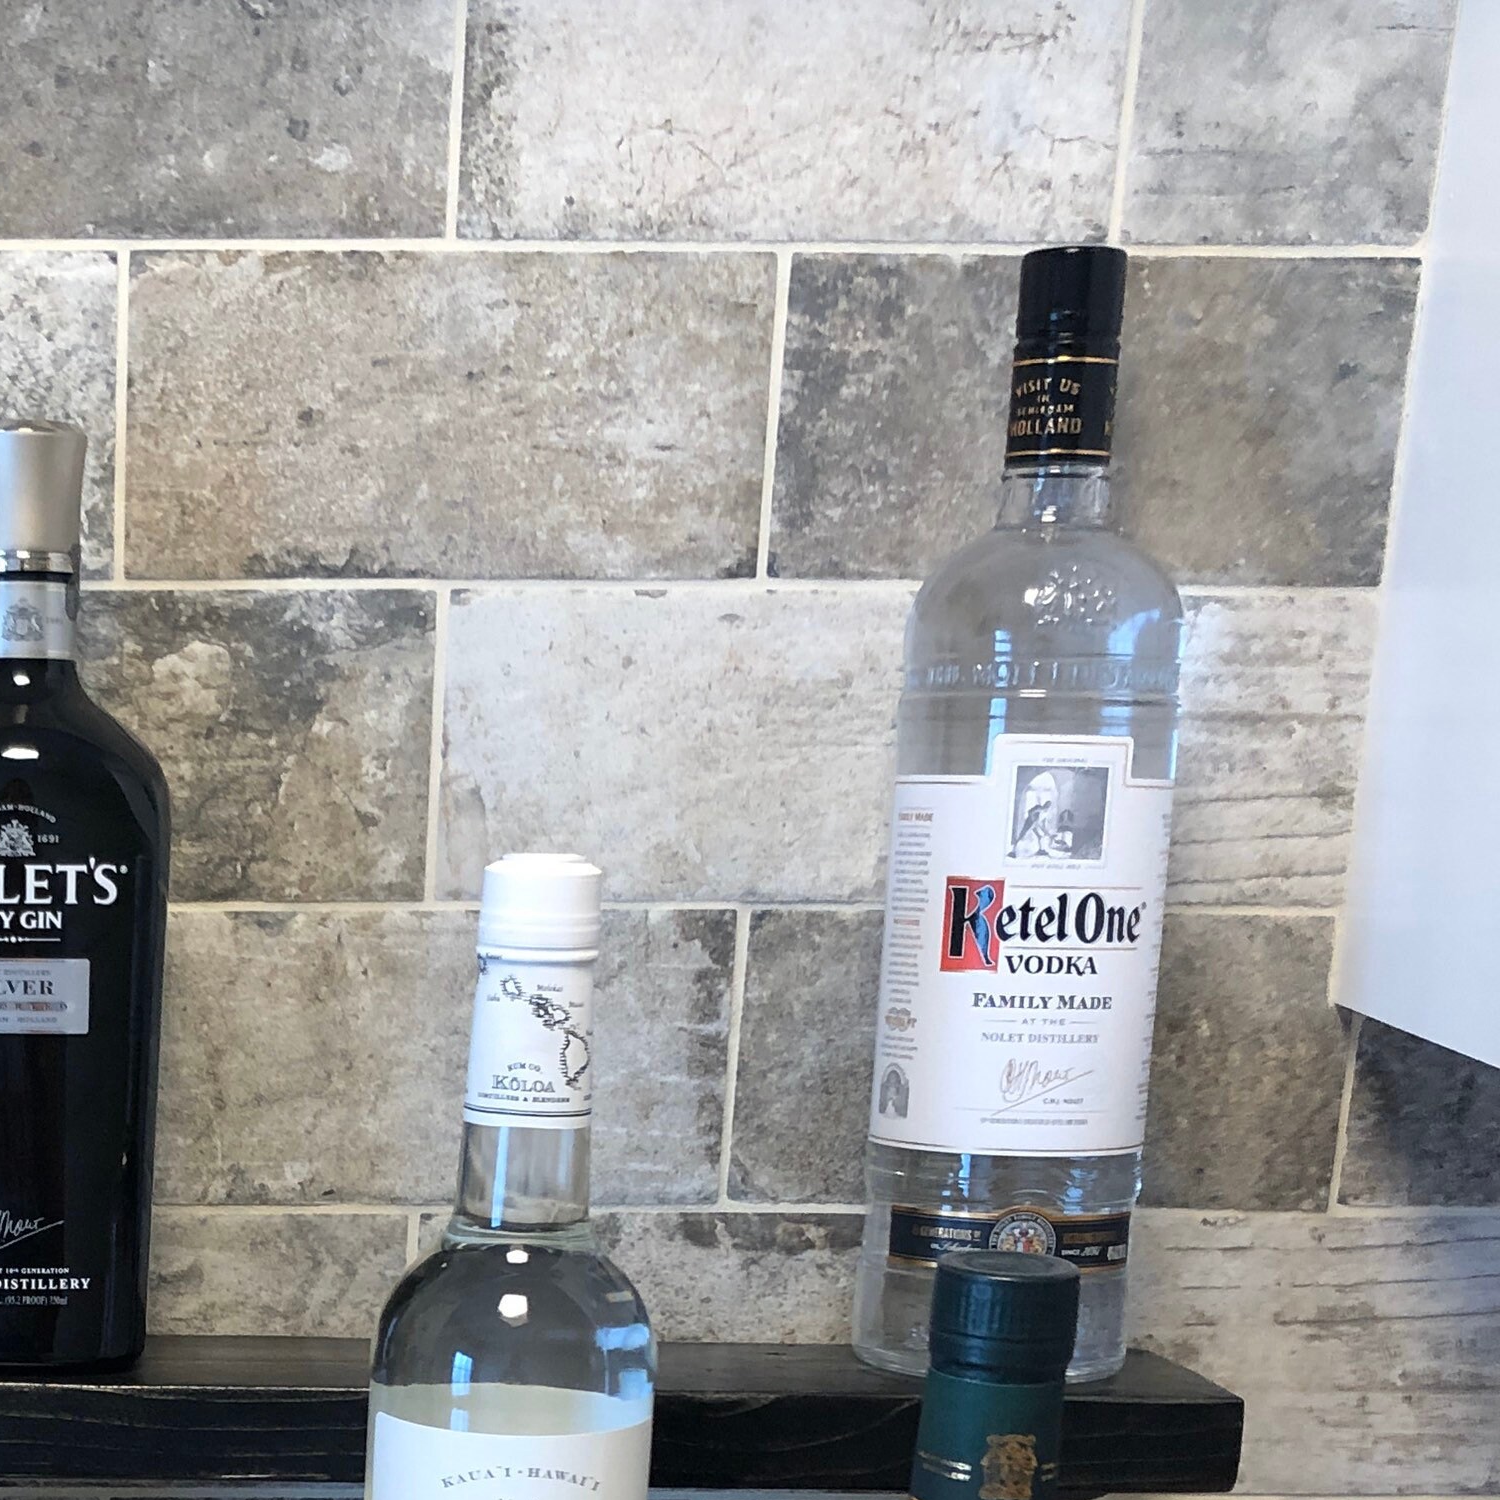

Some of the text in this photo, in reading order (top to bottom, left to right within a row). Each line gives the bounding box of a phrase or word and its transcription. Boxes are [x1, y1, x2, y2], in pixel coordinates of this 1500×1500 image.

[1059, 378, 1081, 396] US
[1010, 417, 1082, 437] HOLLAND
[37, 833, 60, 843] 1691
[20, 911, 62, 930] GIN
[948, 884, 1069, 966] Ketel
[1075, 892, 1141, 944] One
[1004, 955, 1099, 977] VODKA
[971, 992, 1113, 1011] FAMILY MADE
[1021, 1018, 1066, 1026] AT THE
[981, 1032, 1100, 1043] NOLET DISTILLERY
[21, 1267, 70, 1275] GENERATION
